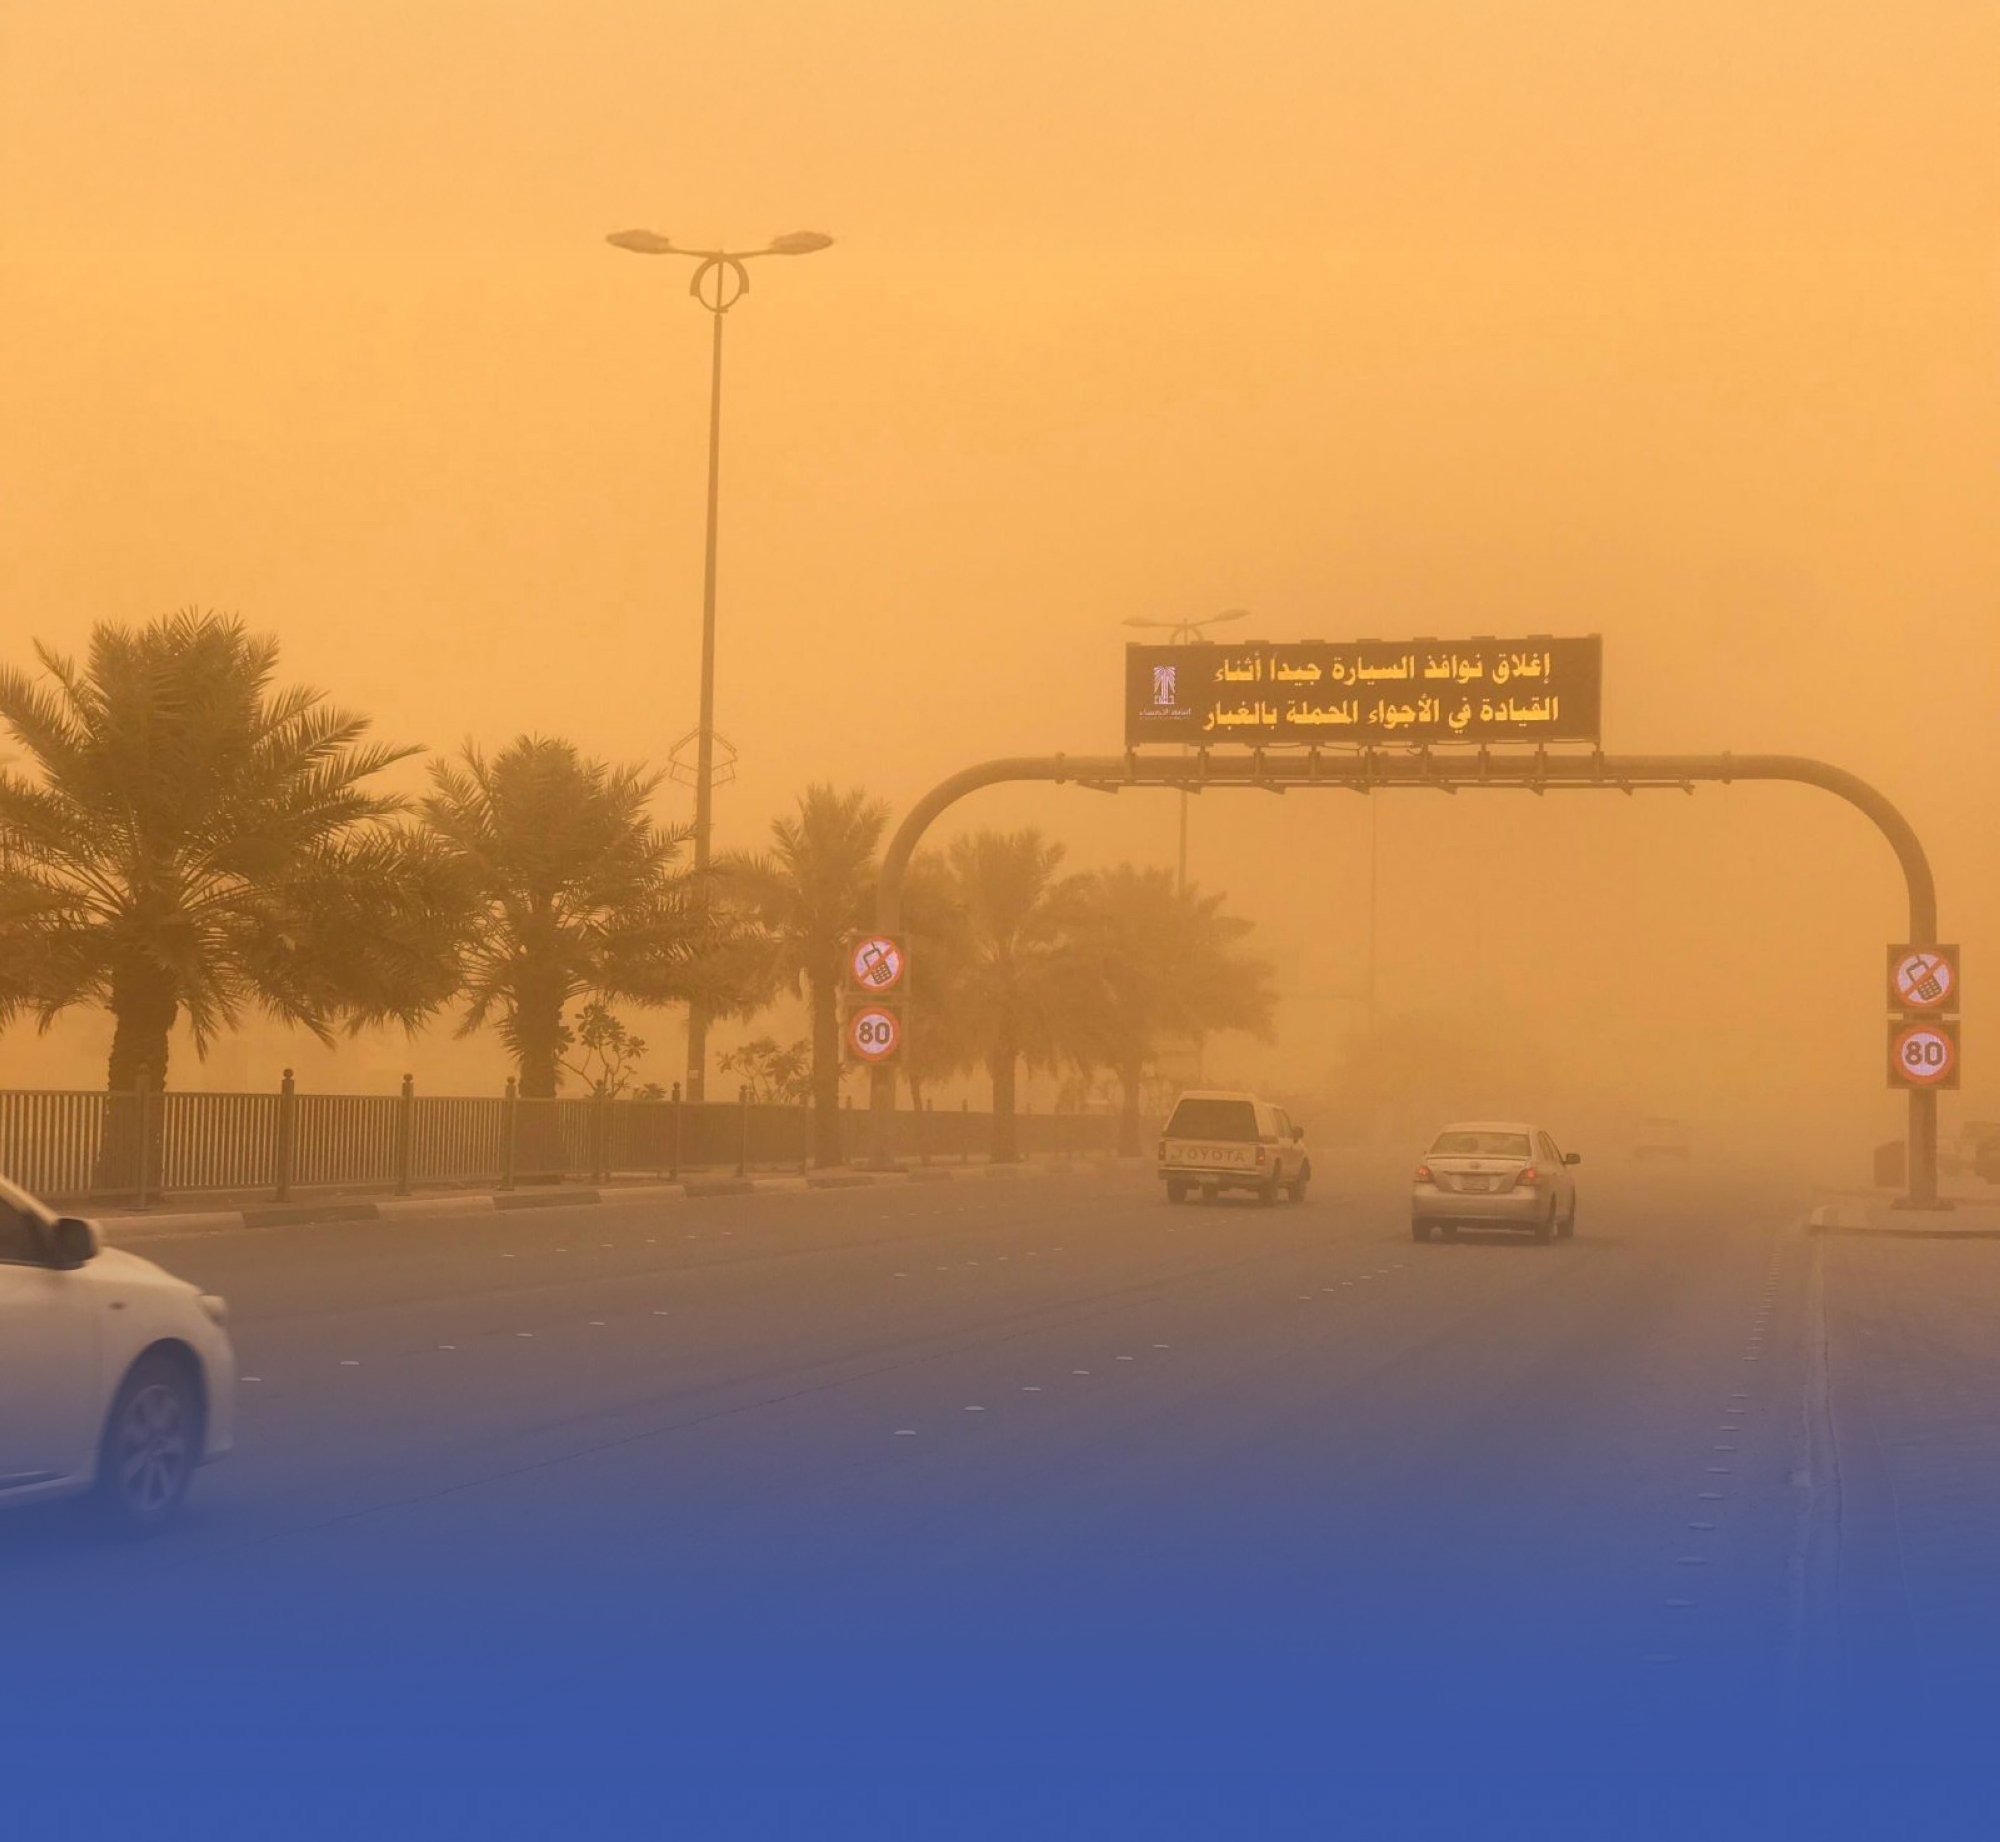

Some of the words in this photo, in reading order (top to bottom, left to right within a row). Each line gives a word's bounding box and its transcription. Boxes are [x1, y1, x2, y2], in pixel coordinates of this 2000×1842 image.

[1213, 651, 1262, 682] أثناء
[1331, 654, 1416, 686] السيارة
[1423, 653, 1484, 685] نوافذ
[1492, 653, 1551, 685] إغلاق
[1202, 699, 1278, 731] بالغبار
[1286, 699, 1359, 725] المحملة
[1367, 693, 1440, 730] الأجواء
[1448, 696, 1472, 734] في
[1479, 695, 1559, 728] القيادة
[858, 1021, 890, 1045] 80
[1904, 1040, 1944, 1066] 80
[1174, 1148, 1246, 1163] TOYOTA
